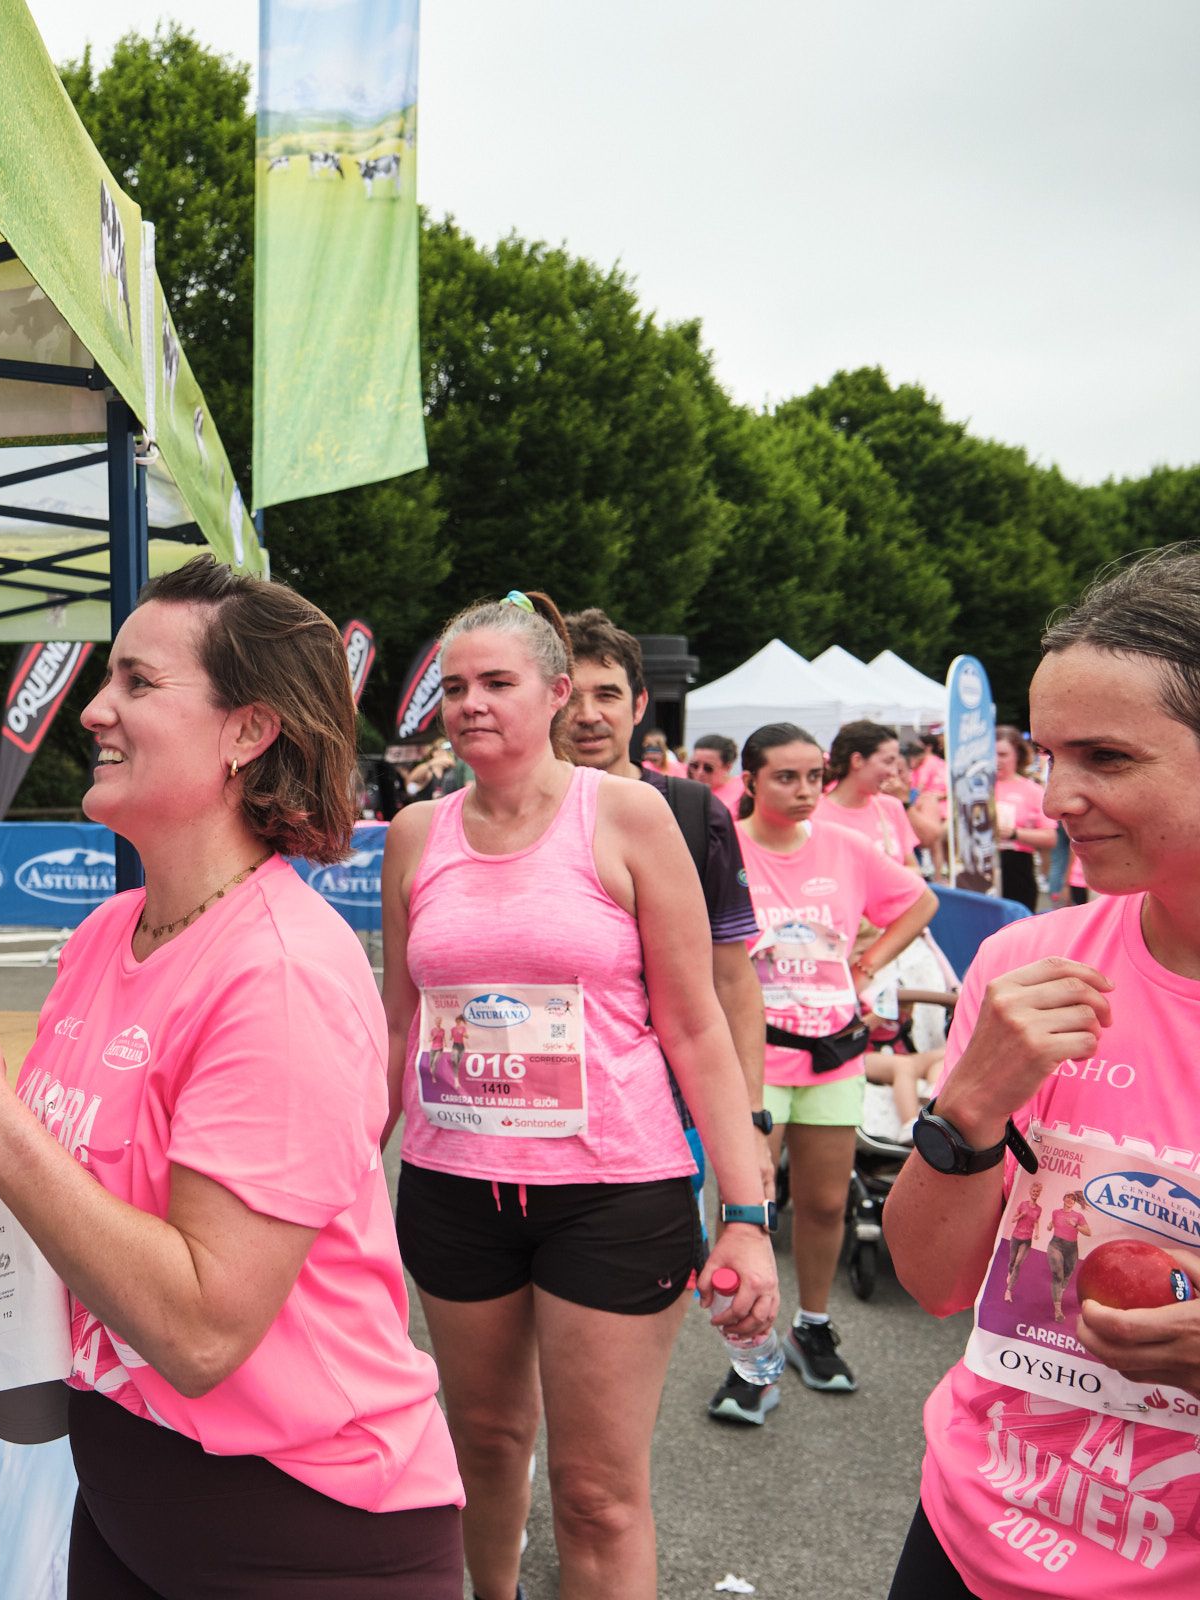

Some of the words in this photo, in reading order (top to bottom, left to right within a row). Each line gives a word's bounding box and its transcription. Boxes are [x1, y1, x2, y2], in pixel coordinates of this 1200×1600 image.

[319, 873, 381, 893] ASTU
[776, 960, 817, 976] 016
[435, 1000, 460, 1009] SUMA
[468, 1006, 525, 1020] ASTURIANA
[466, 1053, 526, 1079] 016
[529, 1056, 578, 1064] CORREDORA
[1051, 1058, 1136, 1089] SHO
[481, 1083, 510, 1095] 1410
[440, 1093, 473, 1105] CARRERA
[475, 1096, 484, 1105] DE
[485, 1096, 497, 1106] LA
[498, 1097, 526, 1107] MUJER
[437, 1110, 482, 1126] OYSHO
[514, 1117, 568, 1129] Santander
[1041, 1145, 1053, 1155] TU
[1053, 1148, 1085, 1164] DORSAL
[1038, 1155, 1082, 1180] SUMA
[1121, 1184, 1167, 1204] CENTRAL
[1175, 1272, 1186, 1301] Giga
[3, 1311, 13, 1319] 112
[1016, 1323, 1086, 1354] CARRERA
[1000, 1349, 1102, 1394] OYSHO
[1173, 1397, 1200, 1417] Sa
[1070, 1415, 1136, 1486] LA
[977, 1428, 1175, 1570] MUJER
[988, 1506, 1078, 1573] 2026
